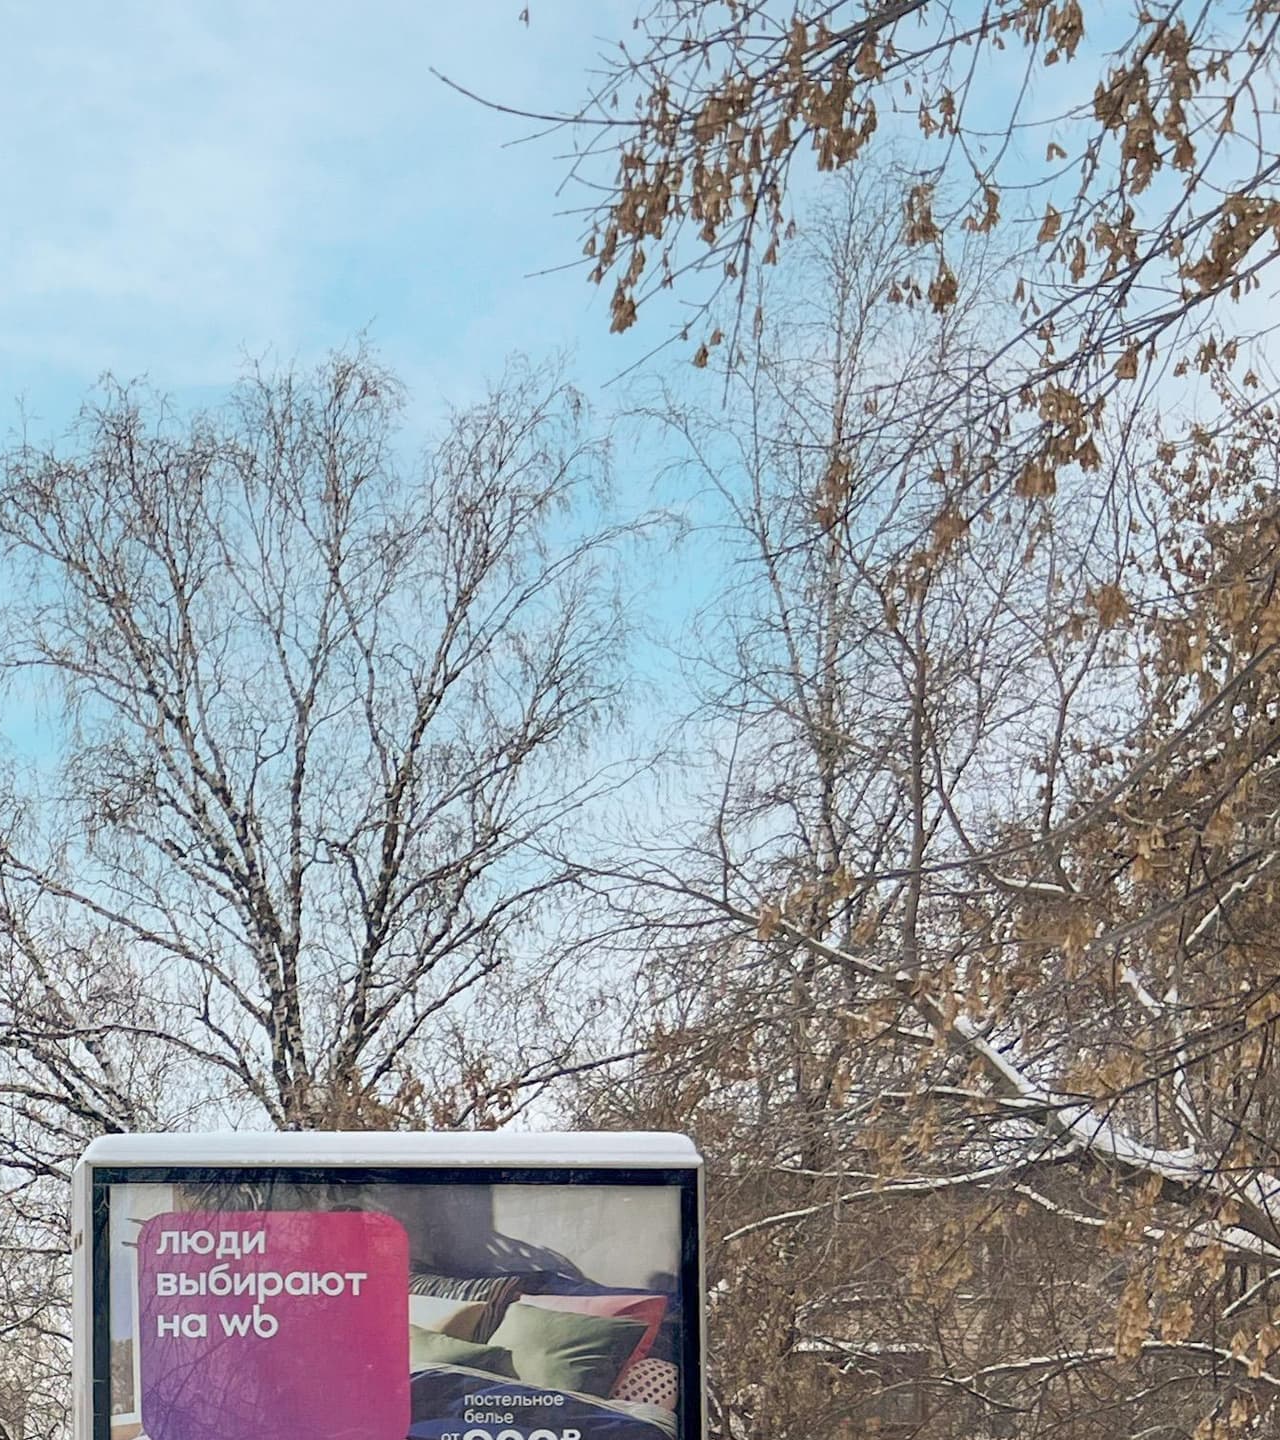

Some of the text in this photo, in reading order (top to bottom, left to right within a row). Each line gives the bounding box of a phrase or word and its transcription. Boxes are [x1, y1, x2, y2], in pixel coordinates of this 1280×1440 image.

[156, 1230, 266, 1259] люди
[156, 1263, 368, 1304] выбирают
[157, 1304, 279, 1338] на wb
[464, 1394, 565, 1407] постельное
[464, 1408, 514, 1424] белье
